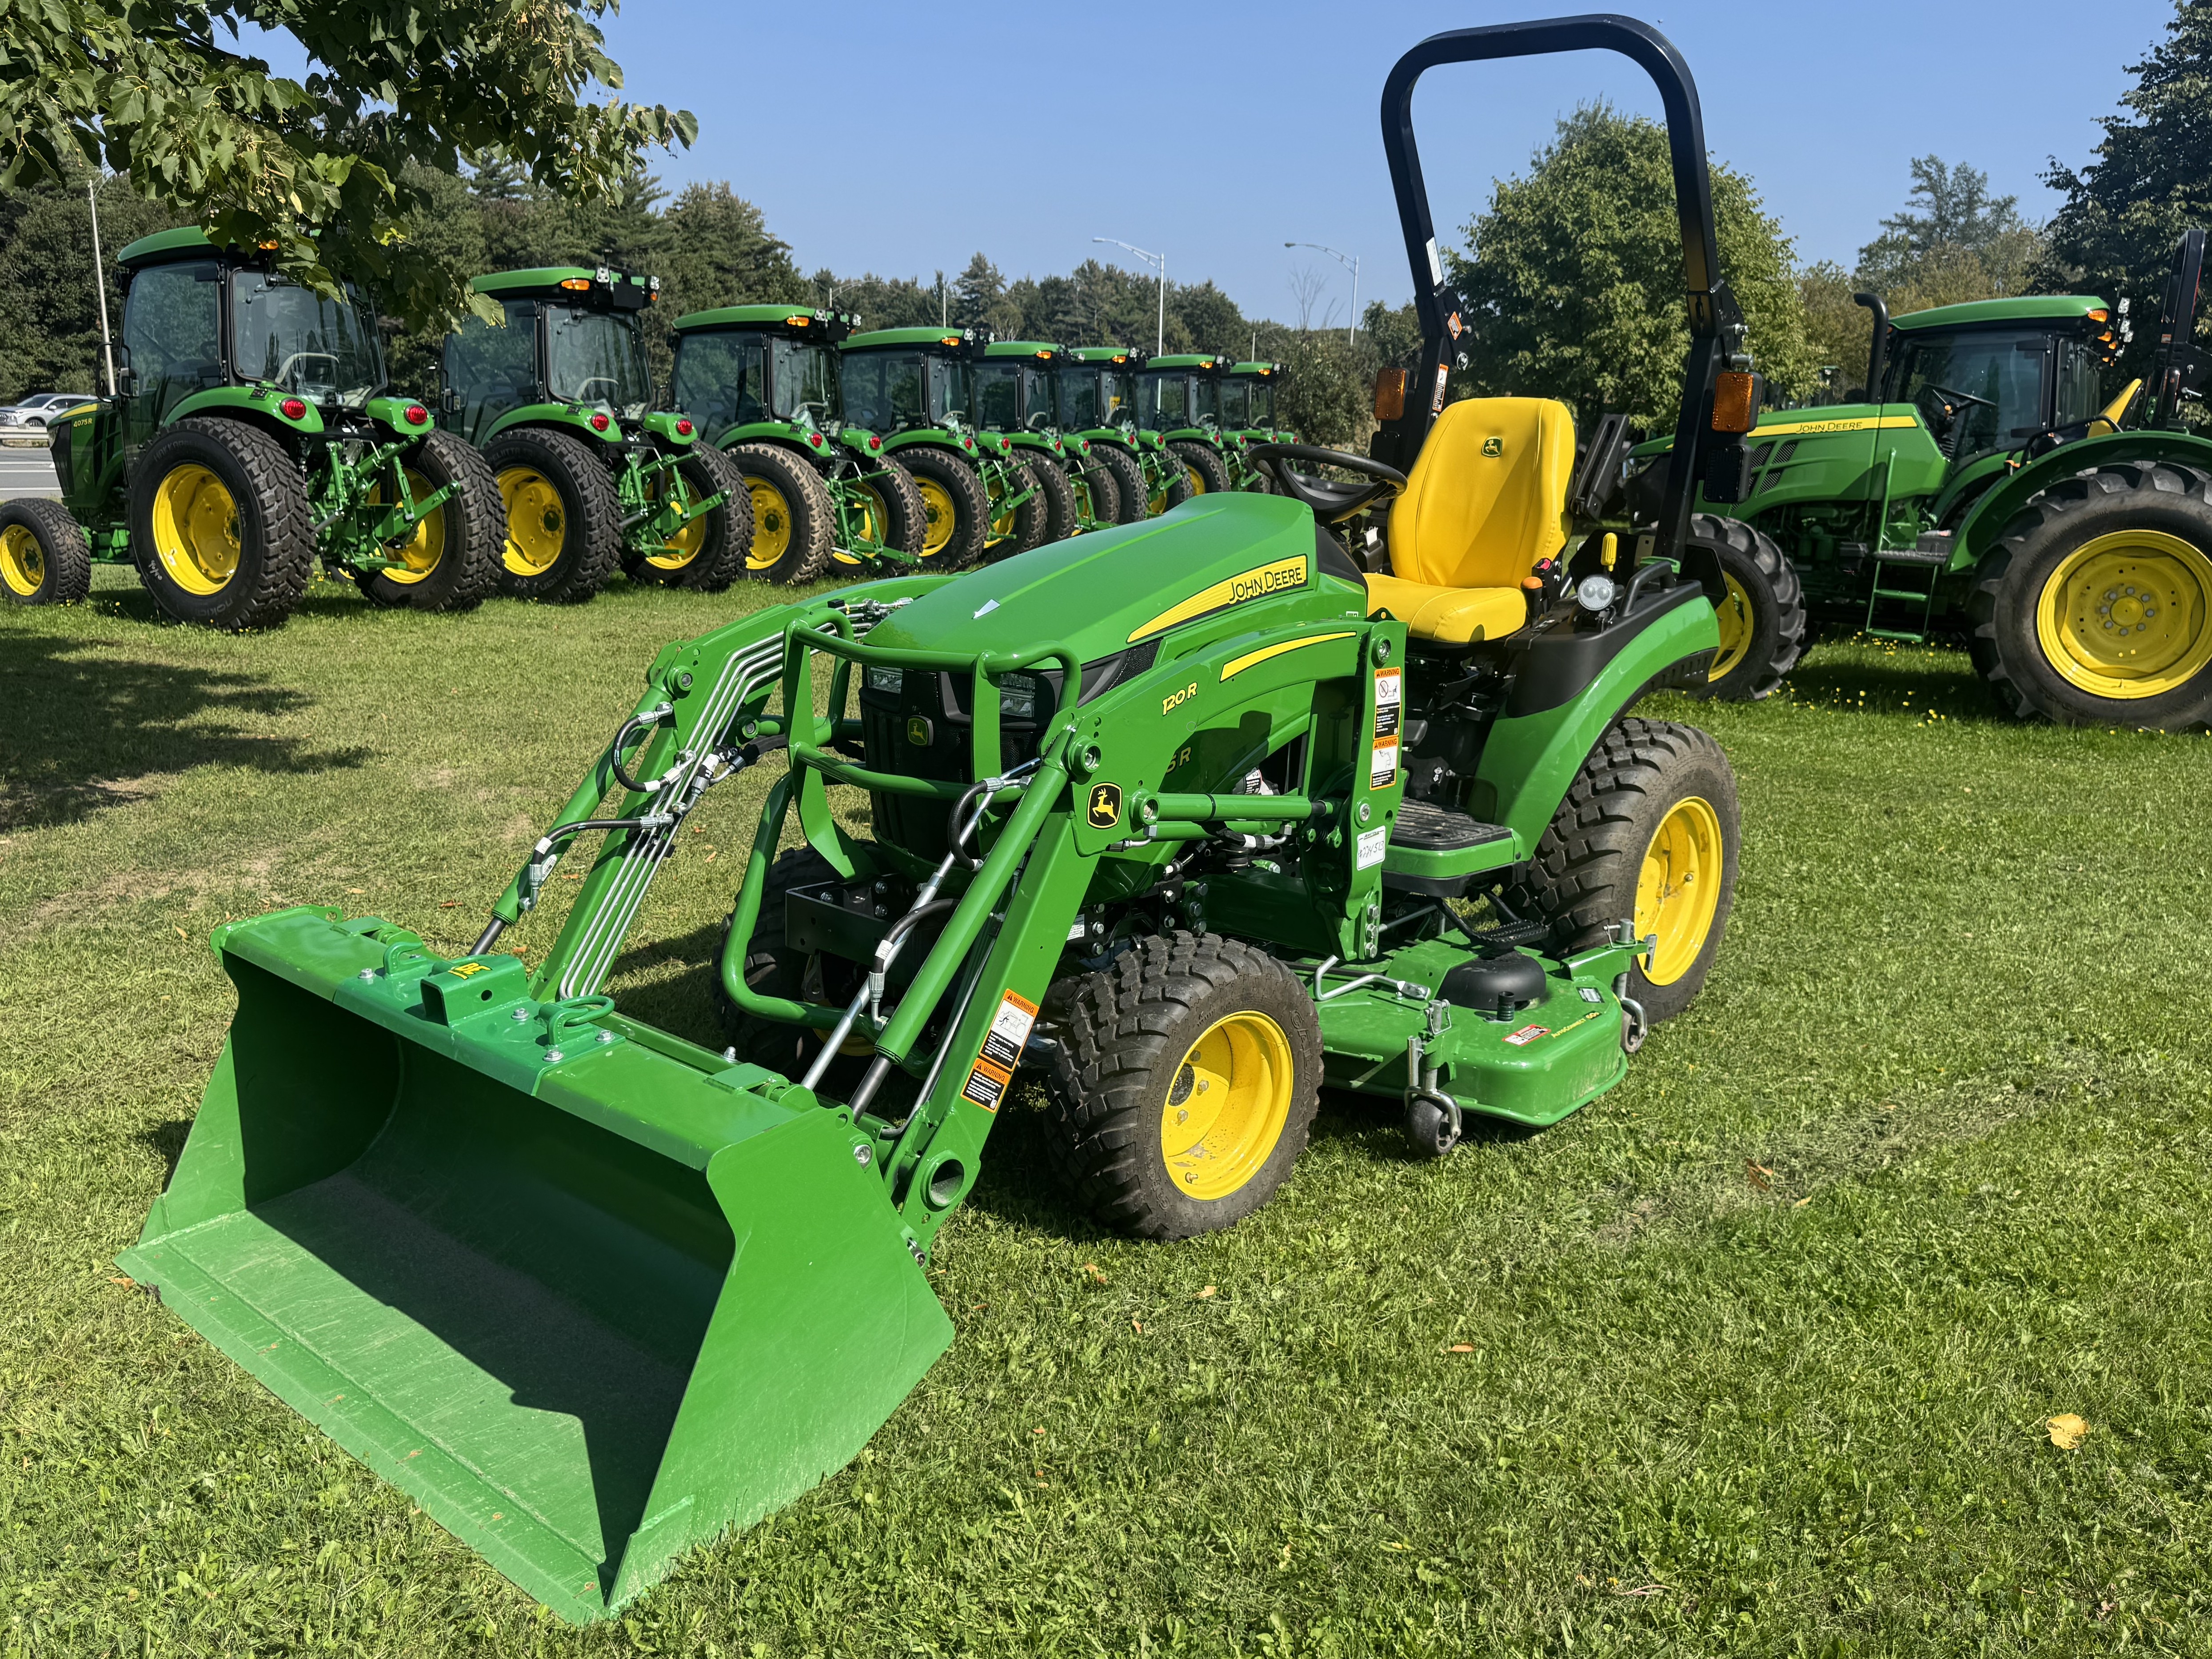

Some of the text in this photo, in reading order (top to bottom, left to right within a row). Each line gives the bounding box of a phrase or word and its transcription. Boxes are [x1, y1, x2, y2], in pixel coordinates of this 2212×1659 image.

[1828, 421, 1863, 430] DEERE
[1229, 567, 1302, 602] JOHN DEERE
[1381, 668, 1399, 677] WARNING
[1378, 738, 1397, 748] WARNING
[1013, 996, 1034, 1014] WARNING
[983, 1065, 1006, 1082] WARNING
